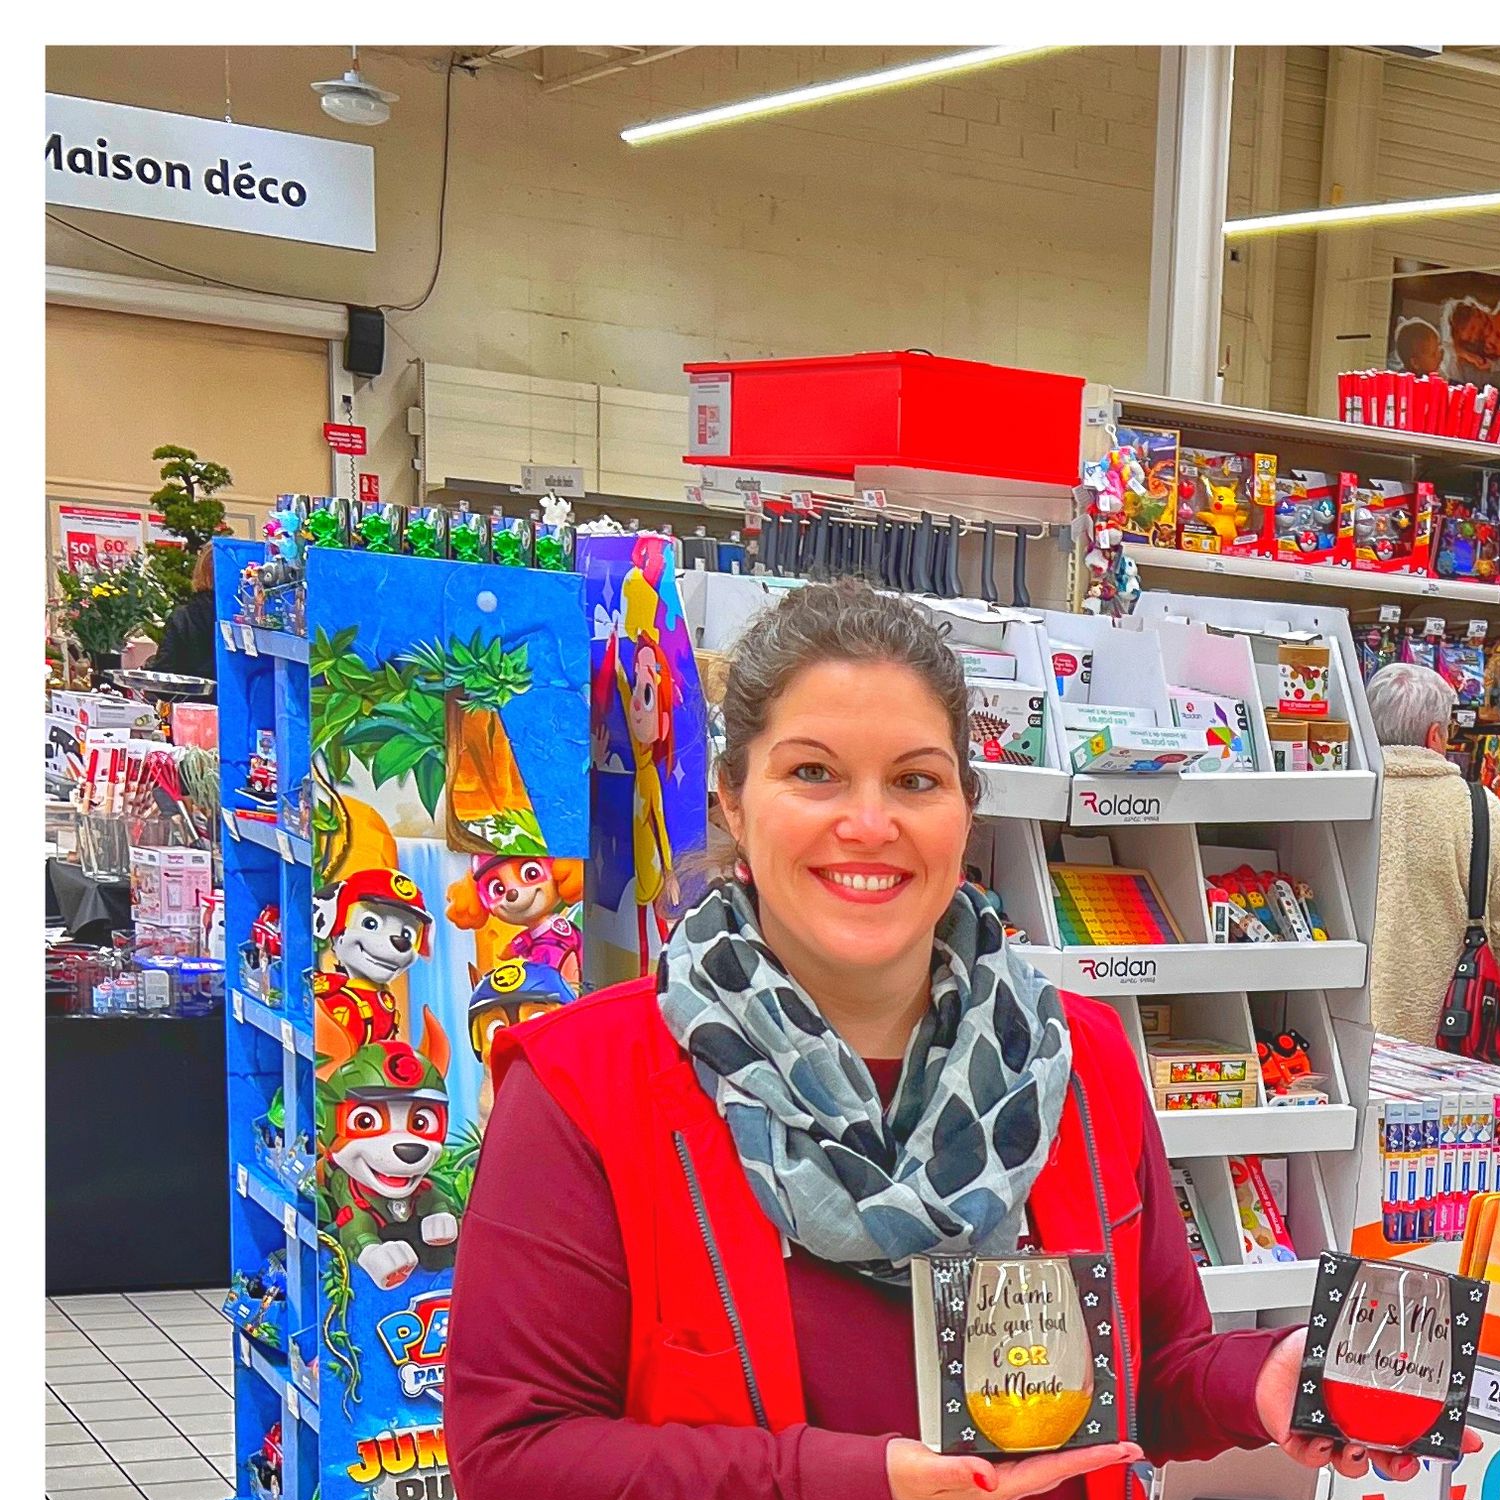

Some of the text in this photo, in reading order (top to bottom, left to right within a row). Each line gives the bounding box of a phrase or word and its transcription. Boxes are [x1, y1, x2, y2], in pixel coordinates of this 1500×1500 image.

[204, 159, 307, 207] déco
[1079, 791, 1161, 817] Roldan
[1078, 956, 1157, 980] Roldan
[967, 1315, 998, 1342] plus
[1003, 1318, 1034, 1339] que
[1348, 1296, 1379, 1326] Toi
[1411, 1303, 1451, 1342] Moi
[376, 1308, 451, 1366] PA
[1335, 1340, 1370, 1366] Pour
[413, 1367, 446, 1386] PAT
[980, 1371, 1064, 1400] du Monde
[347, 1427, 448, 1484] JUN
